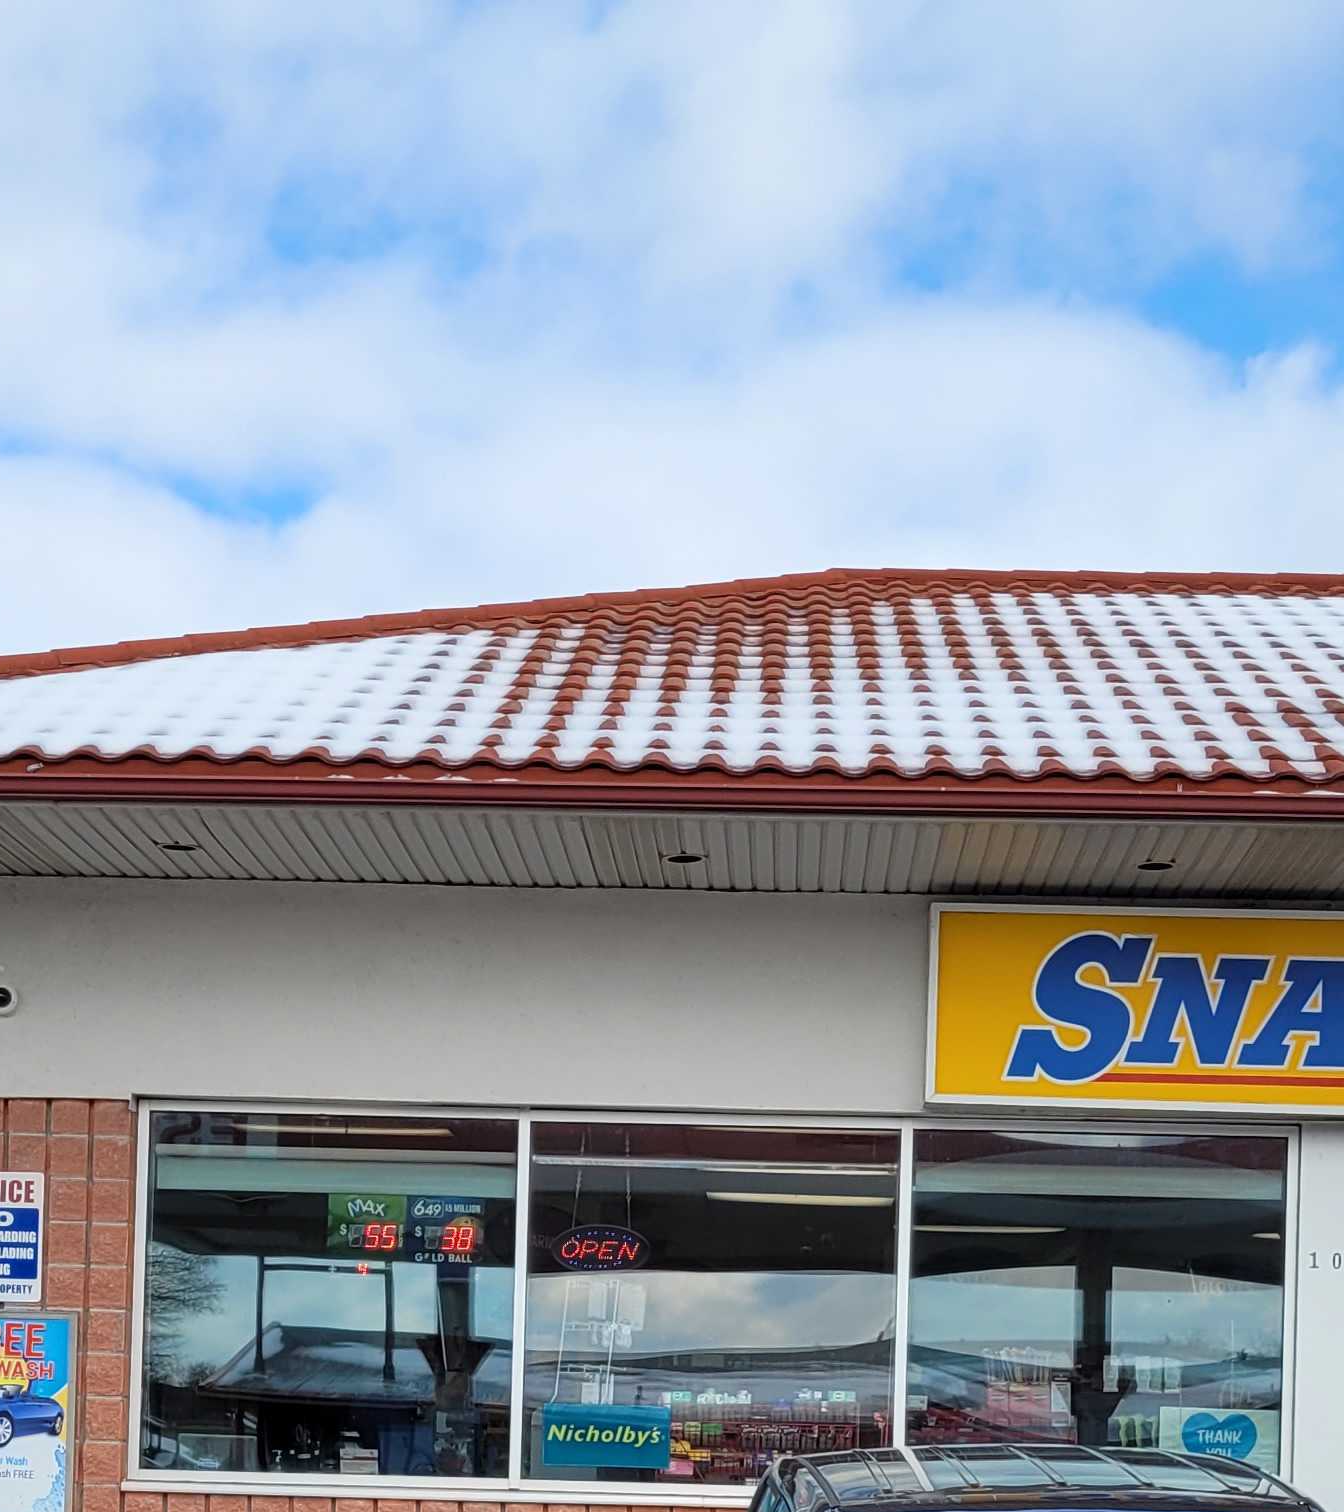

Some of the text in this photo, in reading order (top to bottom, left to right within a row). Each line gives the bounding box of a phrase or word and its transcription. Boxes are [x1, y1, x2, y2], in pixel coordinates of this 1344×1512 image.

[347, 1199, 385, 1217] MAX
[414, 1200, 442, 1216] 649
[365, 1224, 397, 1248] 55
[442, 1226, 472, 1250] 38
[561, 1237, 640, 1260] OPEN
[448, 1254, 472, 1264] BALL
[547, 1424, 661, 1447] Nicholby's
[1196, 1429, 1242, 1445] THANK
[6, 1455, 28, 1466] Wash
[13, 1470, 34, 1479] FREE
